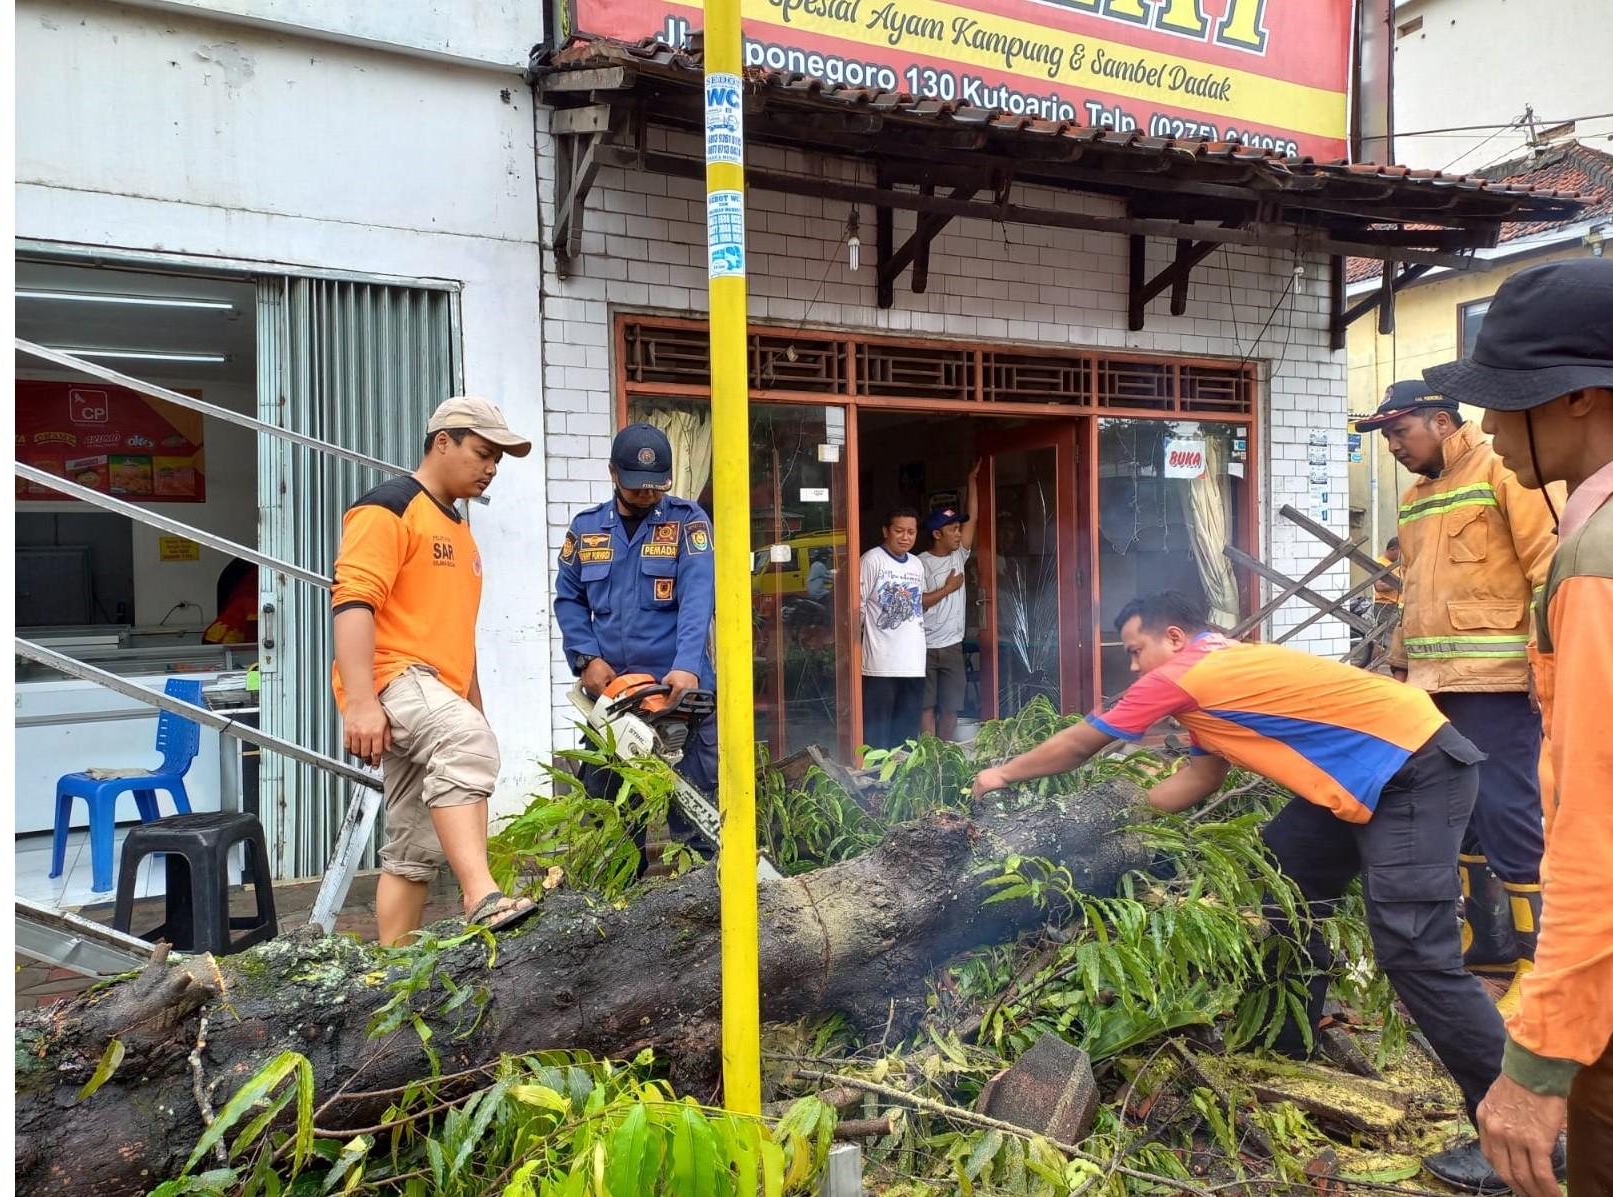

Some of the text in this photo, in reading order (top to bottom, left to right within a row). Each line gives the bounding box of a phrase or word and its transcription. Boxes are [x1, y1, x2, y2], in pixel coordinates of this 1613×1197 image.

[865, 2, 945, 46] Ayam
[951, 16, 1065, 78] Kampung
[1069, 43, 1086, 71] &
[1090, 48, 1168, 88] Sambel
[1167, 65, 1233, 102] Dadak
[744, 40, 896, 91] ponegoro
[906, 66, 956, 101] 130
[962, 77, 1074, 122] Kutoarjo
[1085, 101, 1137, 132] Telp
[706, 88, 740, 108] WC
[81, 406, 106, 421] CP
[1168, 450, 1203, 468] BUKA
[433, 542, 455, 562] SAR
[644, 545, 677, 556] PEMADA
